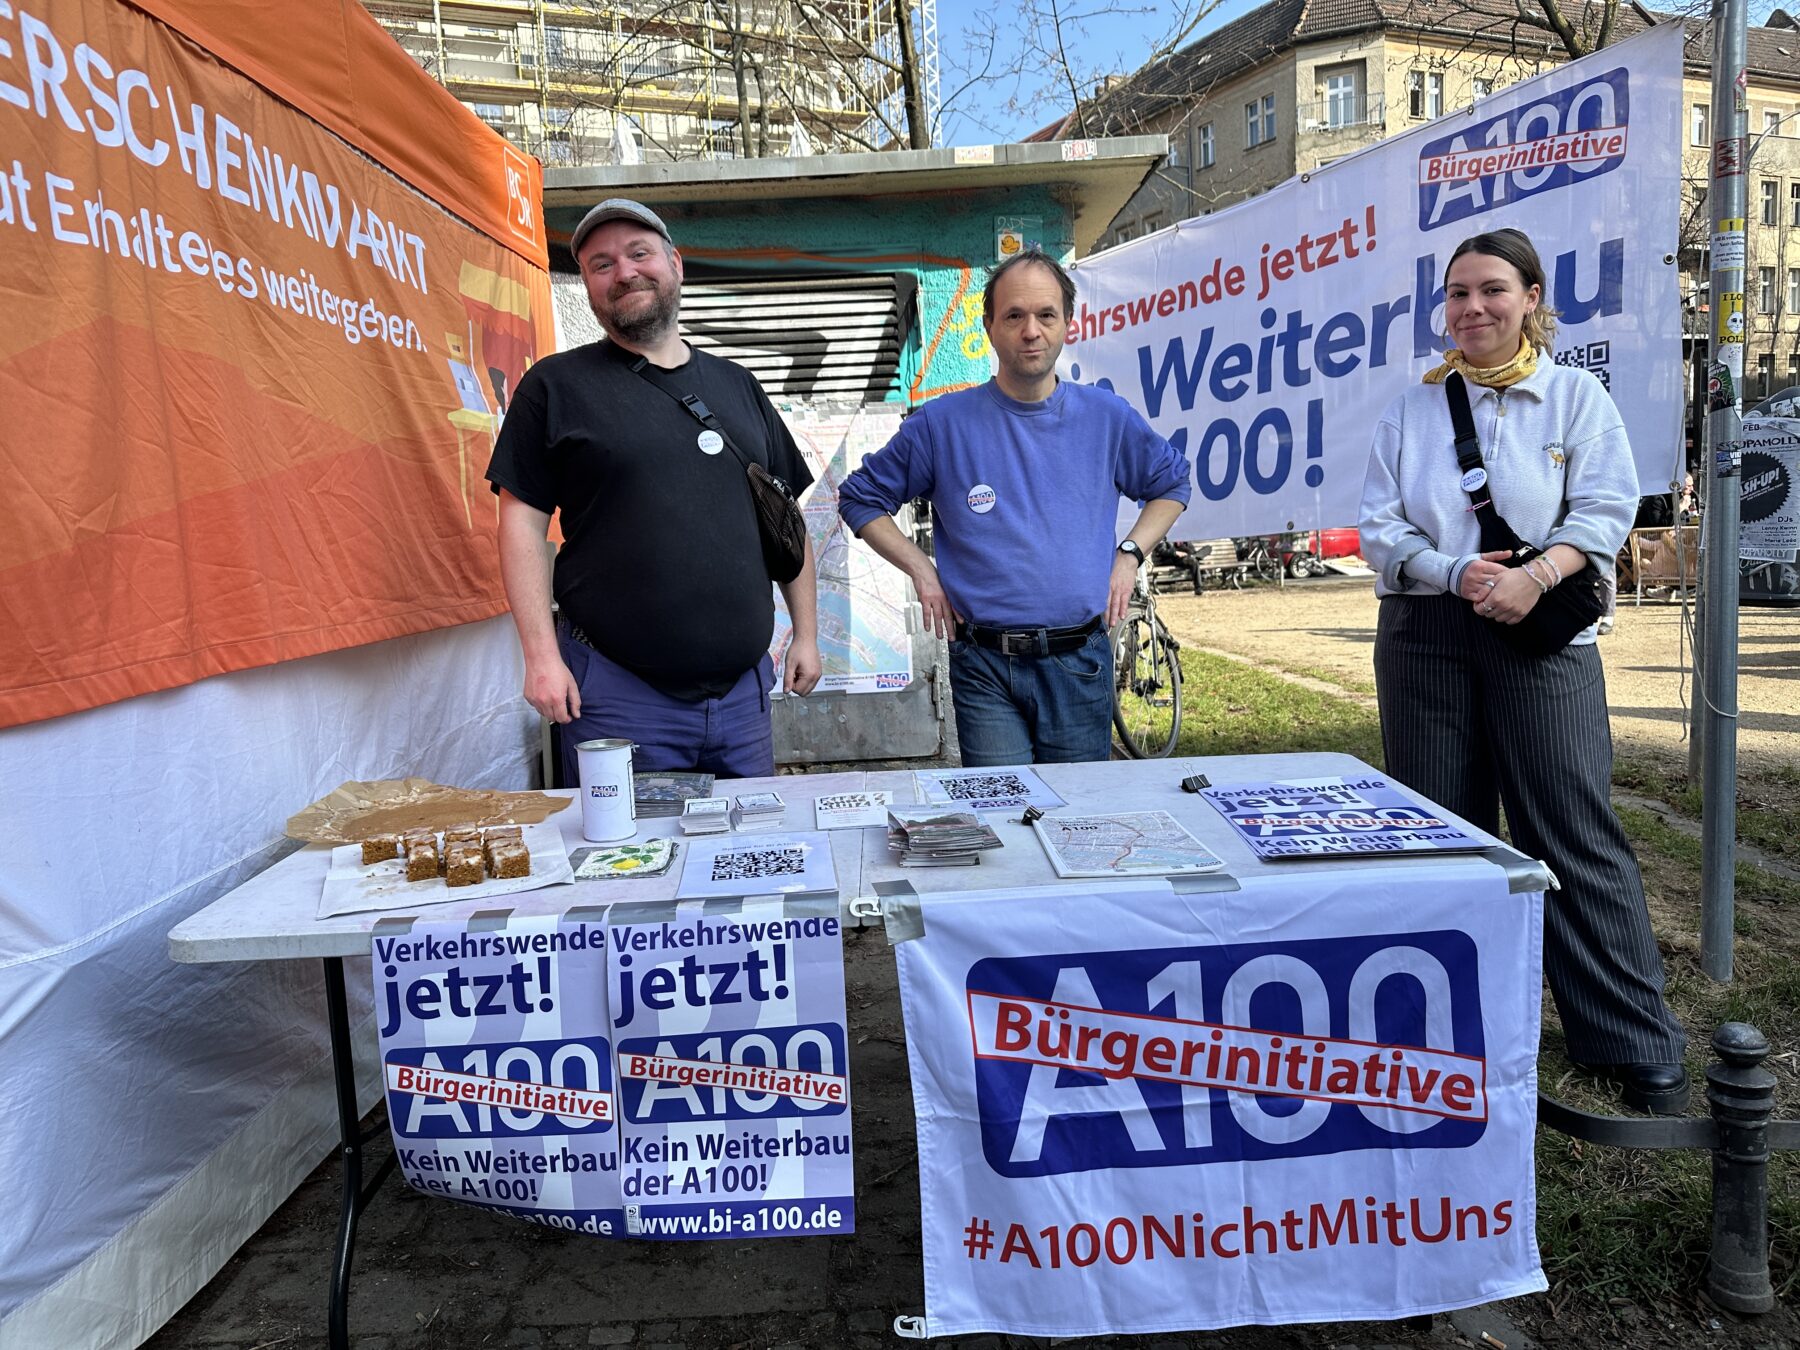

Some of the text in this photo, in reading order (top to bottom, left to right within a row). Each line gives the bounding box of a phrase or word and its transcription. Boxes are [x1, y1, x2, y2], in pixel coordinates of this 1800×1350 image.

[1427, 131, 1623, 180] Bürgerinitiative
[507, 166, 533, 230] BSR
[1257, 205, 1376, 302] jetzt!
[1137, 237, 1624, 419] Weiterbu
[1204, 780, 1386, 799] Verkehrswende
[1217, 791, 1362, 813] jetzt!
[1244, 818, 1440, 827] Bürgerinitiative
[1256, 830, 1468, 849] Kein Weiterbau
[376, 923, 605, 964] Verkehrswende
[612, 916, 839, 953] Verkehrswende
[381, 956, 555, 1038] jetzt!
[614, 944, 790, 1028] jetzt!
[636, 1028, 834, 1118] A100
[995, 1002, 1476, 1112] Bürgerinitiative
[1007, 946, 1455, 1162] A100
[396, 1067, 609, 1118] Bürgerinitiative
[405, 1043, 600, 1133] A100
[630, 1056, 842, 1100] Bürgerinitiative
[399, 1147, 617, 1174] Kein Weiterbau
[624, 1130, 850, 1164] Kein Weiterbau
[410, 1173, 539, 1202] der A100!
[623, 1164, 767, 1197] der A100!
[639, 1204, 842, 1236] www.bi-a100.de
[963, 1195, 1513, 1270] #A100NichtMitUns
